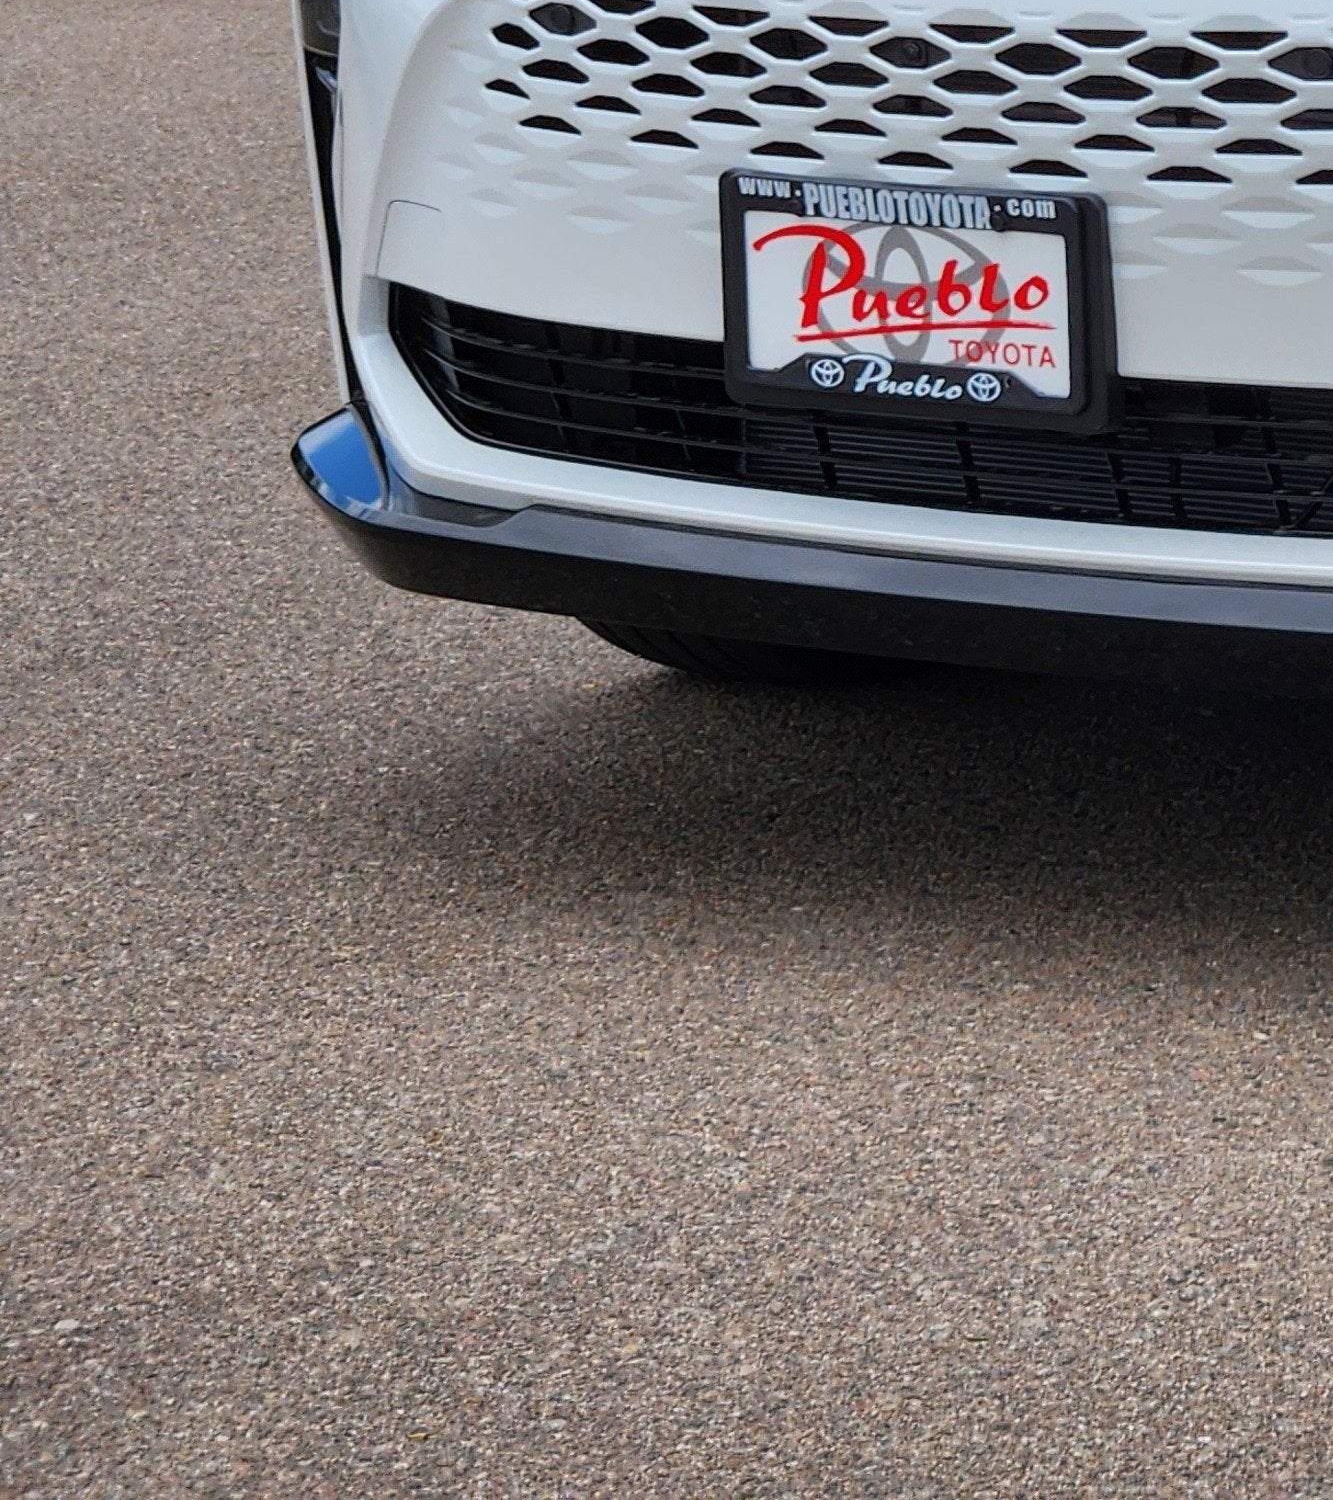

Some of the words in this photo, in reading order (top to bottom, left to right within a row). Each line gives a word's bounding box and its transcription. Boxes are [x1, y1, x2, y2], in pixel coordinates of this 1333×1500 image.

[752, 223, 1050, 328] Pueblo
[841, 354, 964, 400] Pueblo
[948, 339, 1057, 369] TOYOTA
